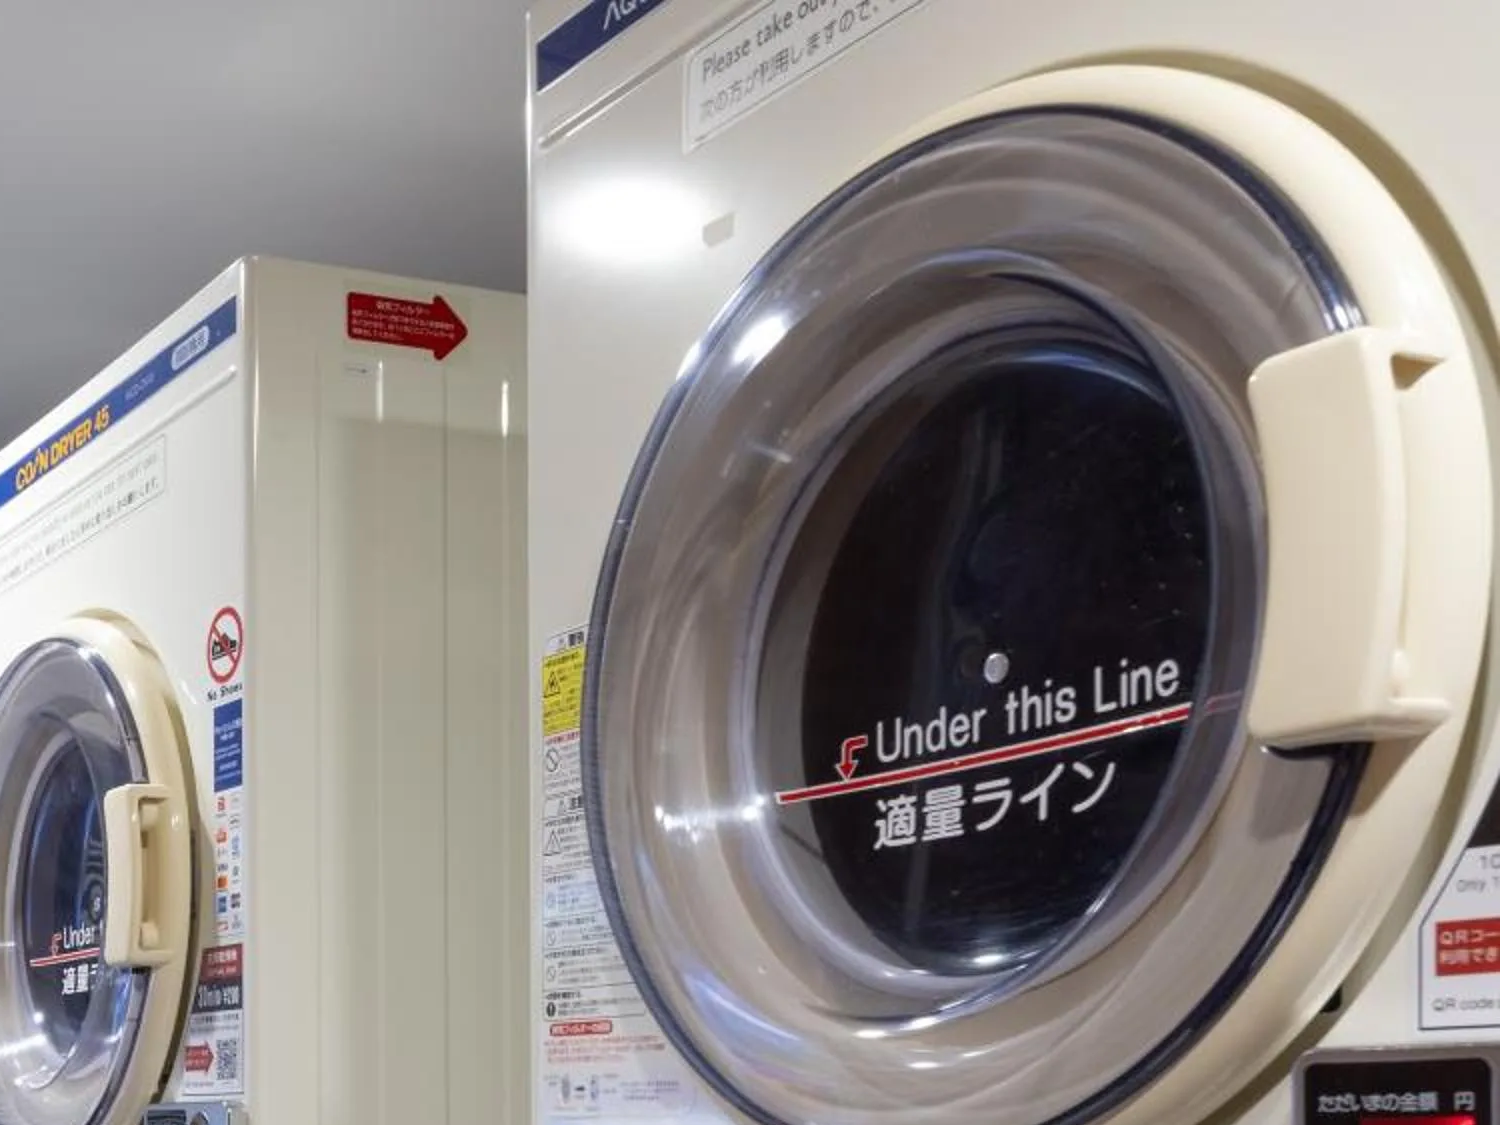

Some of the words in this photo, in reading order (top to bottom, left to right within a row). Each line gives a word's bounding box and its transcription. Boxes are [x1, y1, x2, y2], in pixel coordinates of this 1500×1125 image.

[703, 39, 751, 82] Please
[756, 11, 794, 47] take
[51, 420, 93, 464] DRYER
[875, 709, 986, 764] Under
[1005, 678, 1077, 735] this
[1093, 656, 1181, 712] Line
[872, 761, 1117, 851] 適量ライン
[63, 922, 96, 949] Under
[1453, 1091, 1476, 1112] 円
